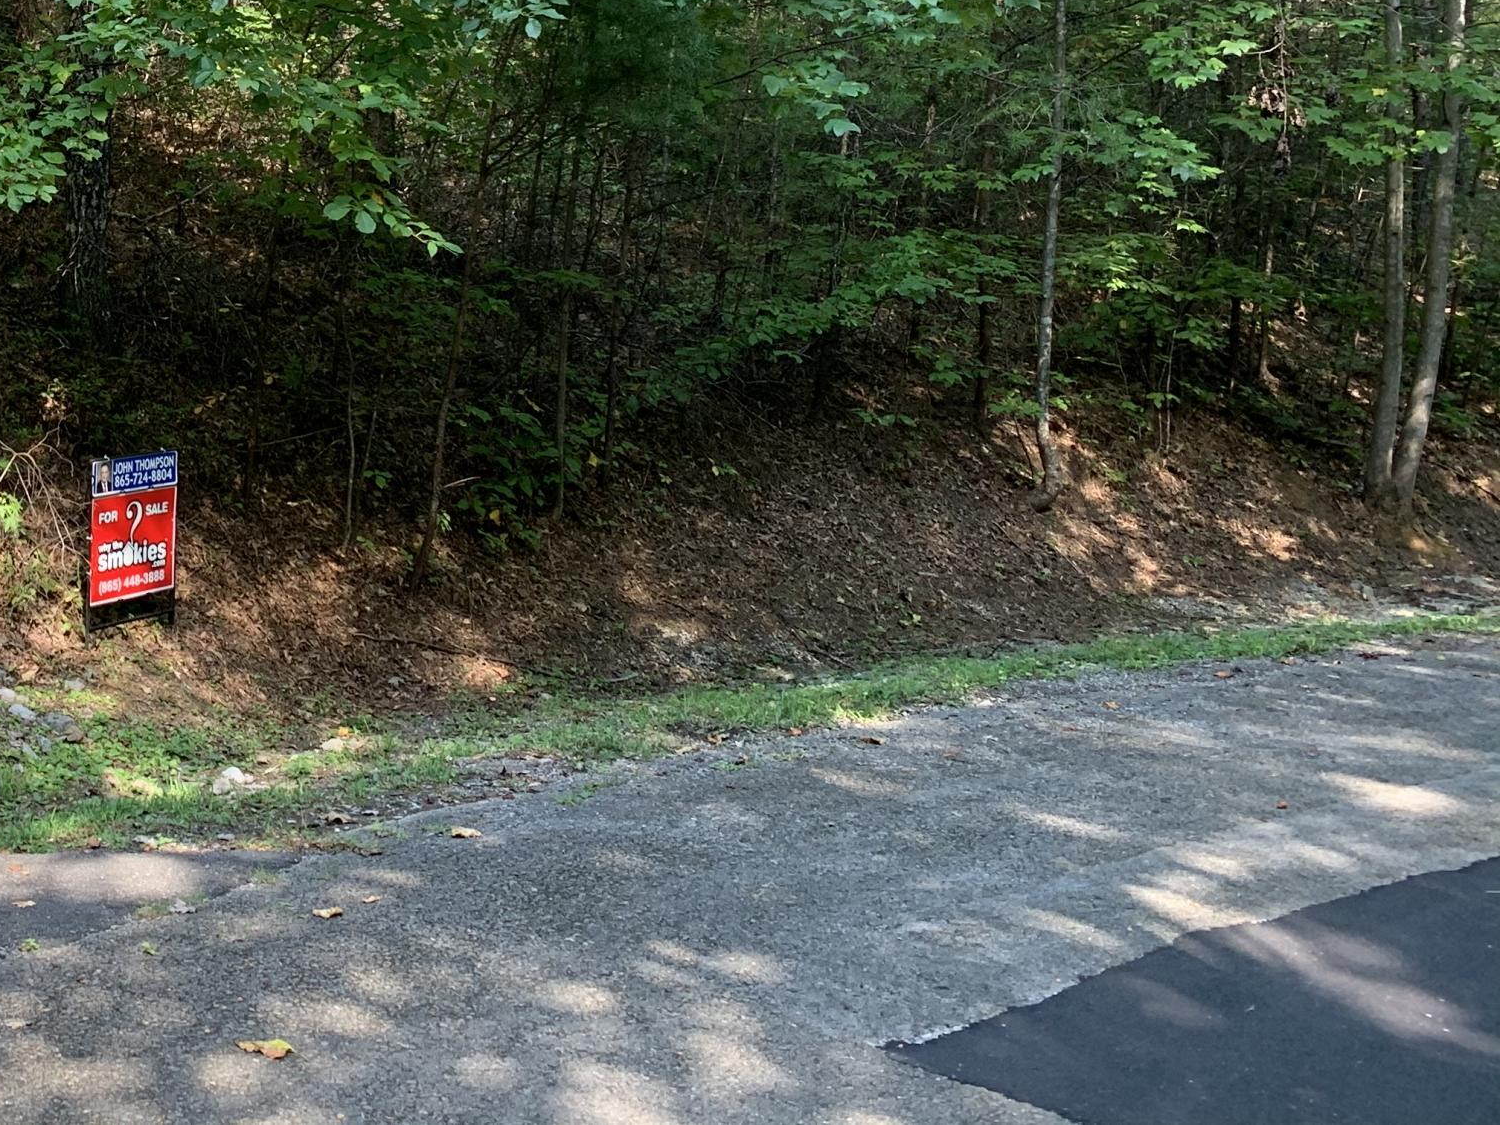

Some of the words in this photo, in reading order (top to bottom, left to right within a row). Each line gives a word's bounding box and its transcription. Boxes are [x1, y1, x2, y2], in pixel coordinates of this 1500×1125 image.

[114, 461, 133, 475] JOHN
[135, 455, 174, 472] THOMPSON
[114, 468, 172, 488] 865-724-8804
[99, 510, 118, 525] FOR
[145, 501, 169, 516] SALE
